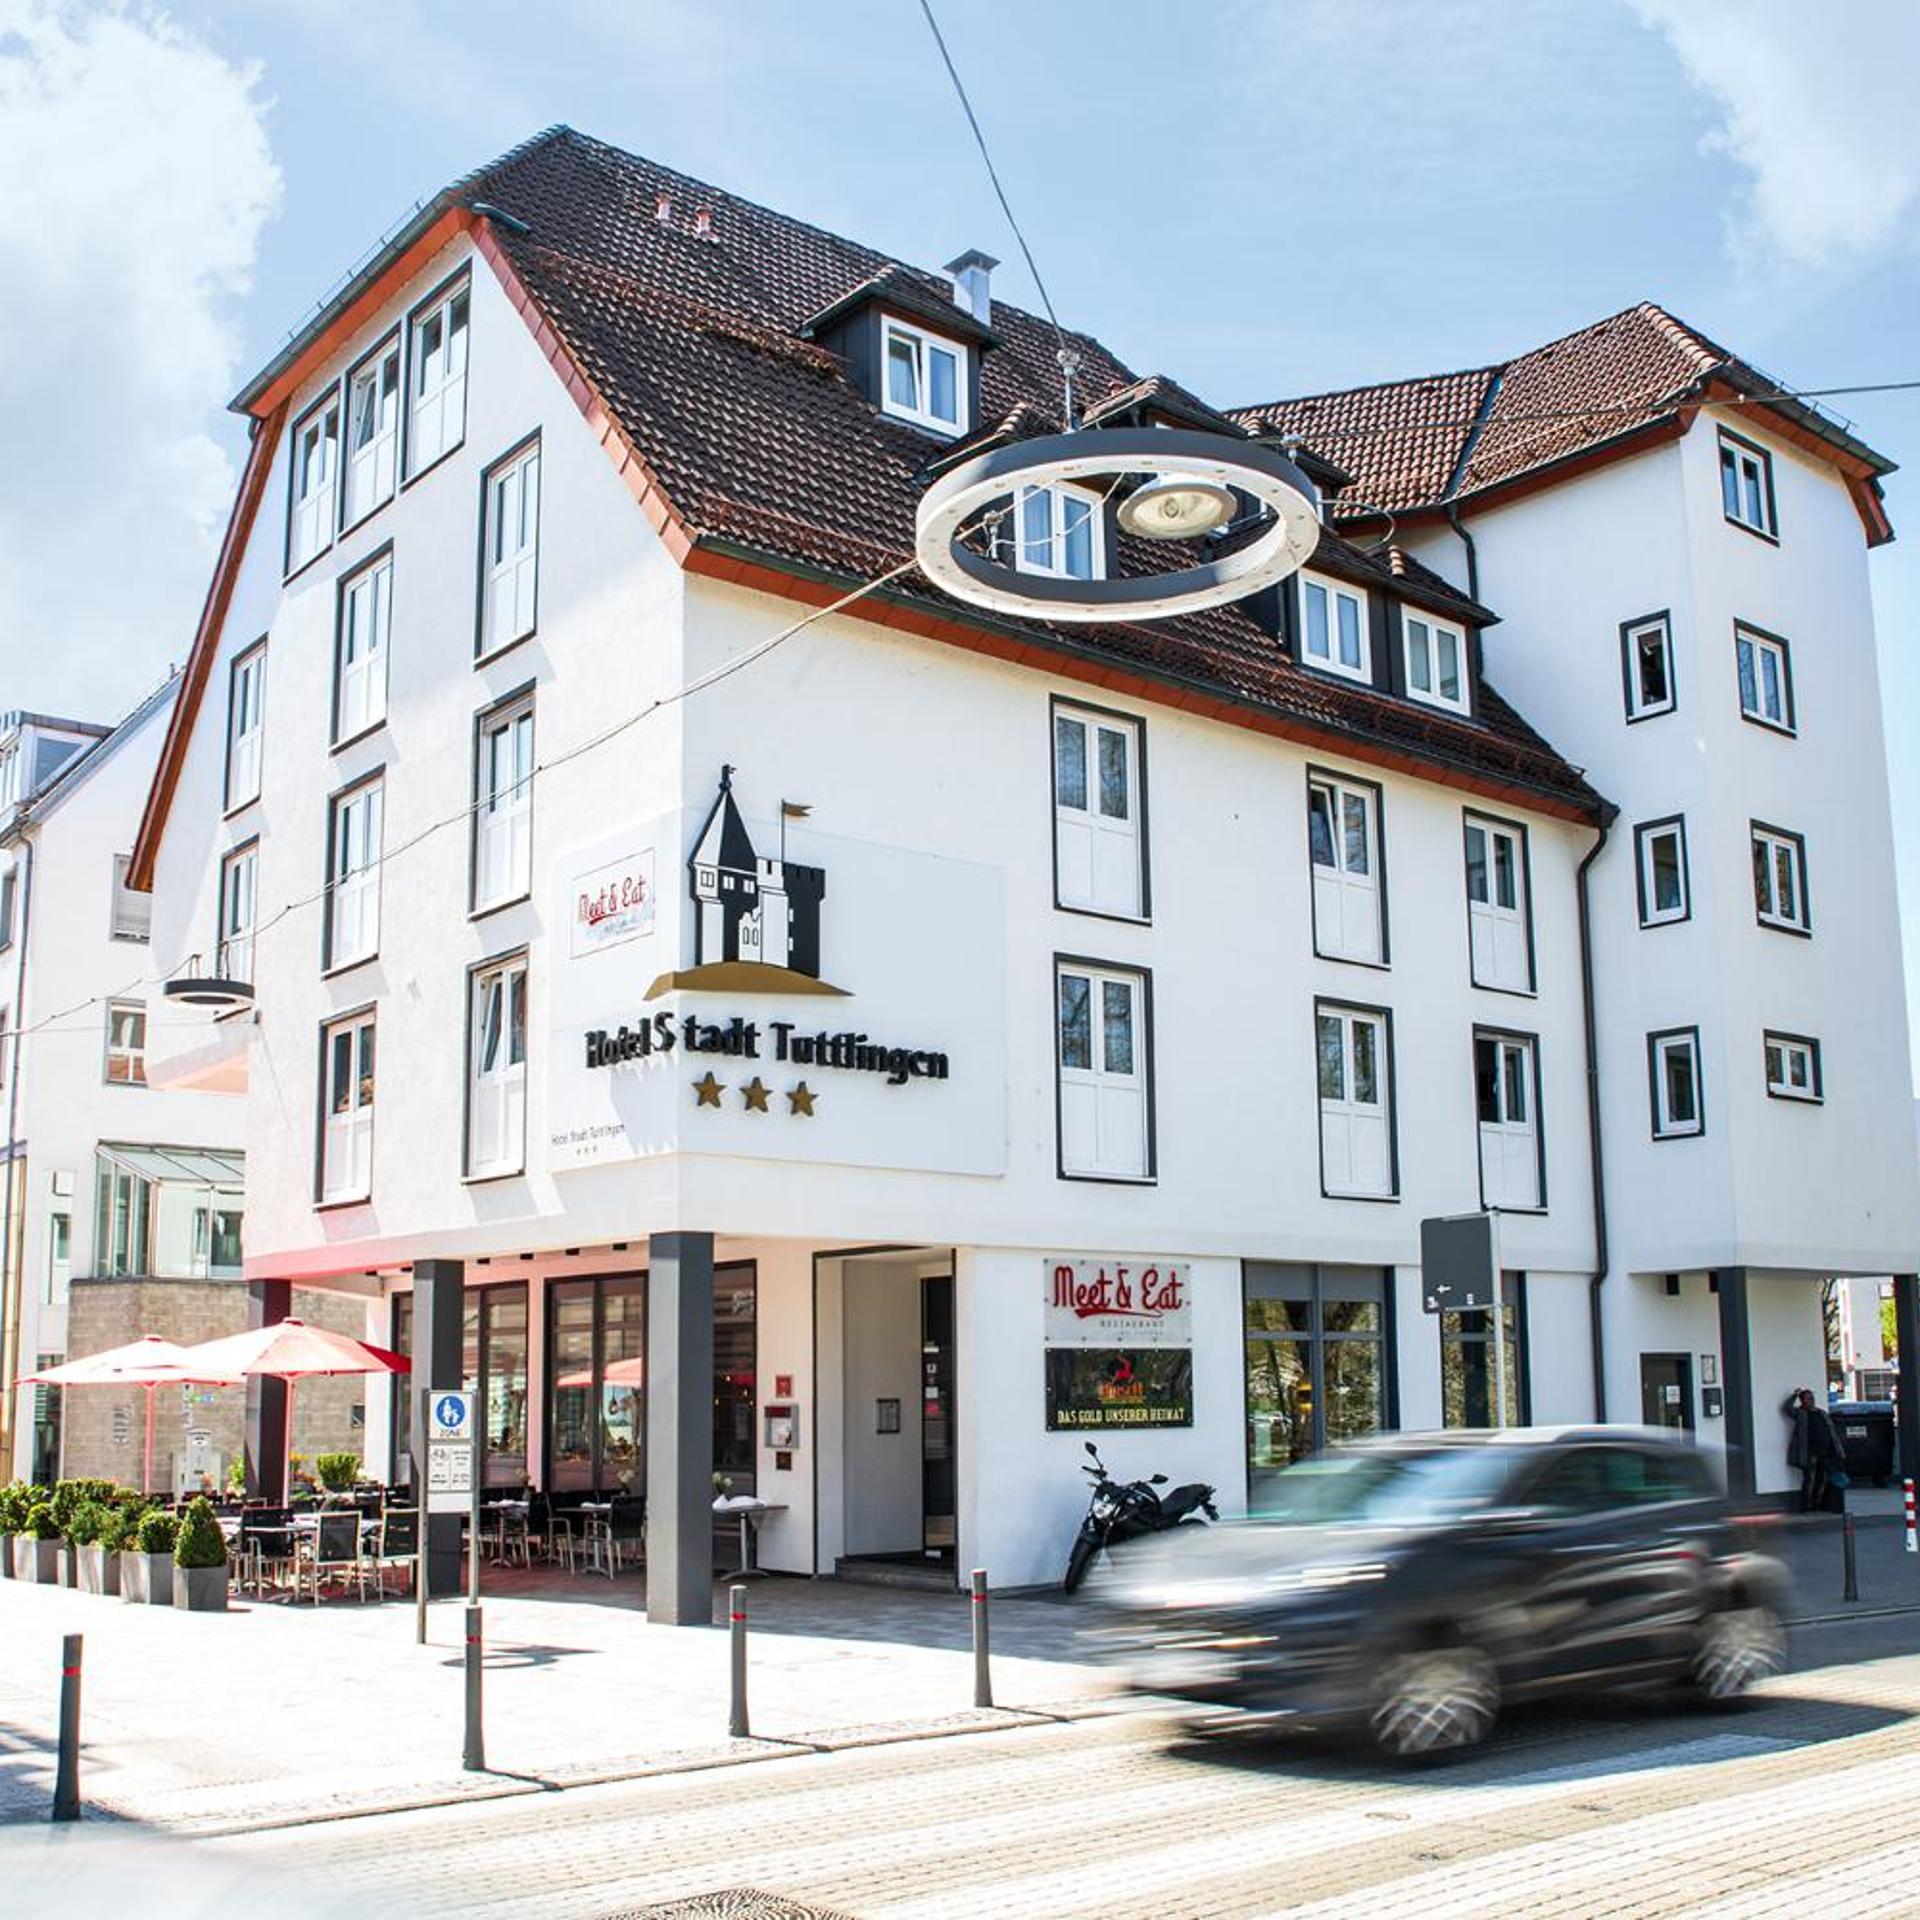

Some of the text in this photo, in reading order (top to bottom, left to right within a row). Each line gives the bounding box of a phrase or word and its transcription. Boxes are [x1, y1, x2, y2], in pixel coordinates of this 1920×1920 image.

[622, 875, 647, 908] Eat
[584, 1016, 651, 1068] Hotel
[769, 1021, 949, 1085] Tuttlingen
[1053, 1266, 1184, 1310] Meet & Eat
[1101, 1320, 1164, 1328] RESTAURANT
[1057, 1407, 1185, 1424] DAS GOLD UNSERER HEIMAT
